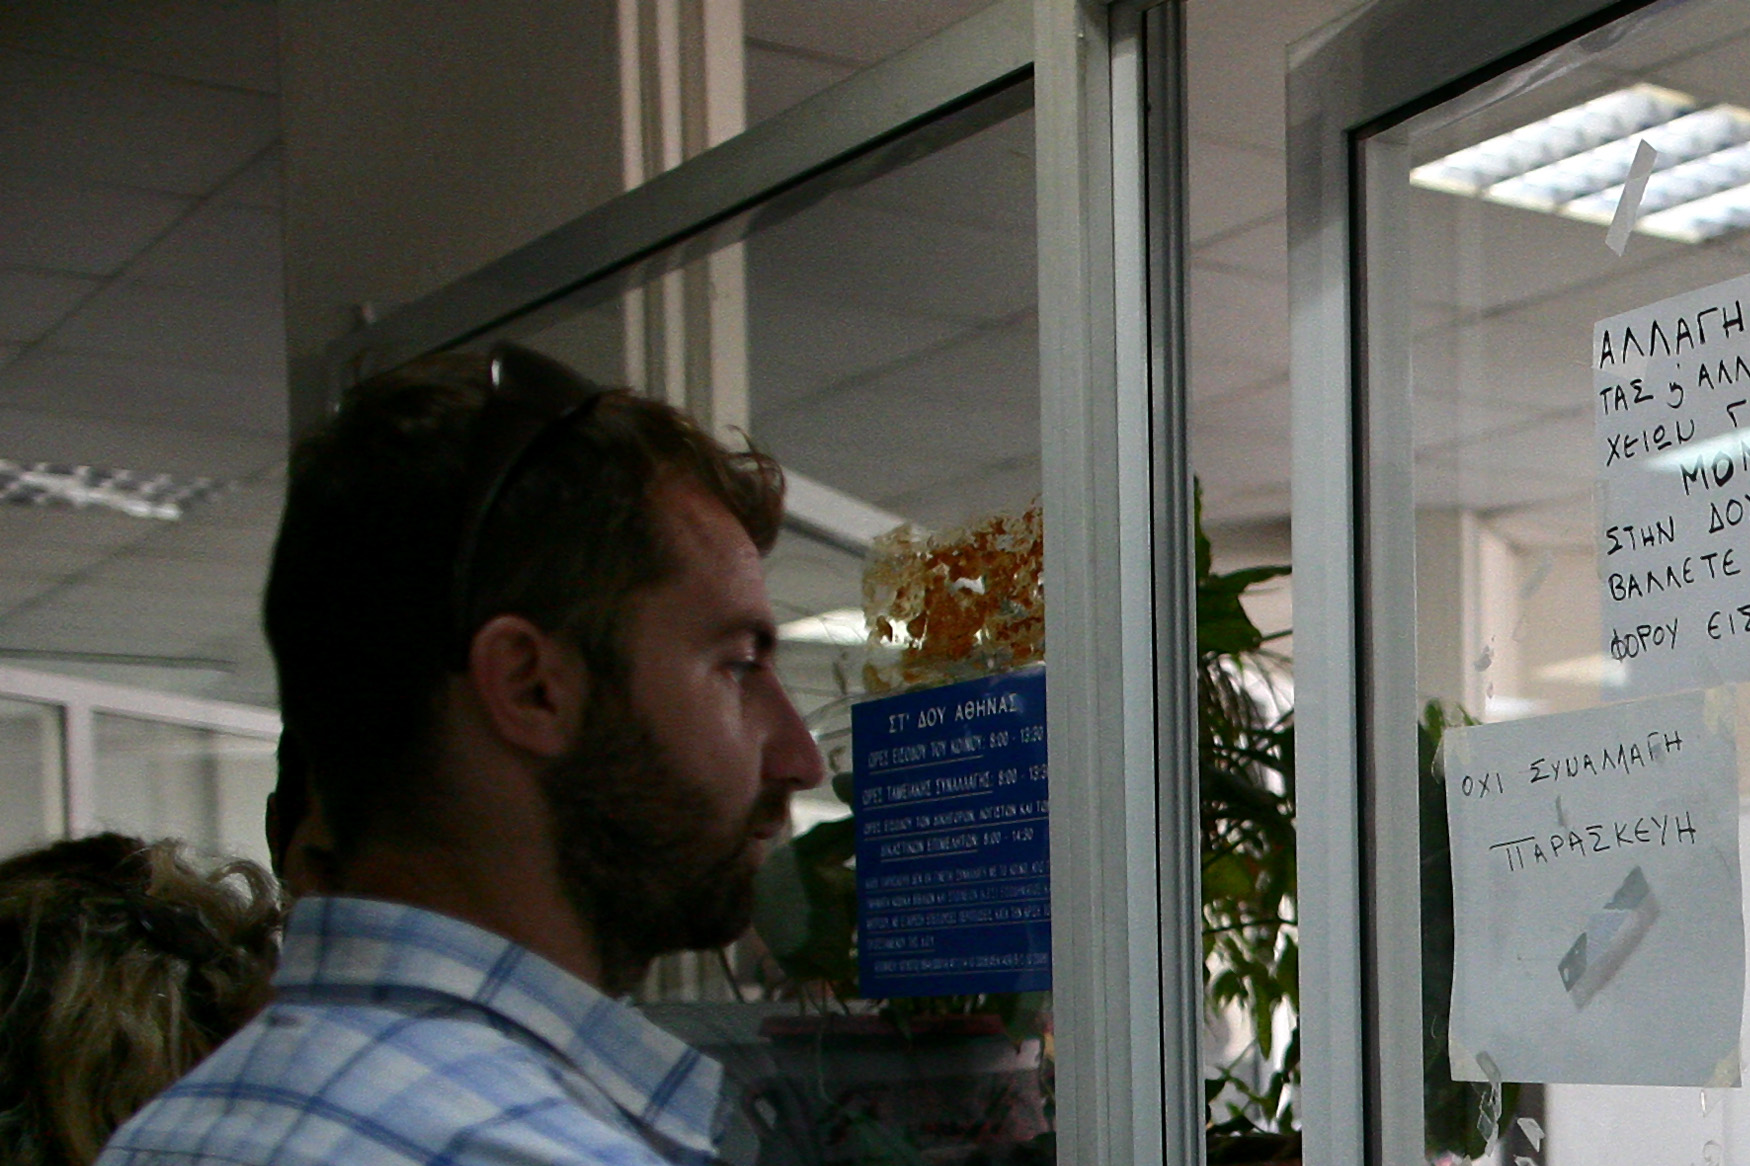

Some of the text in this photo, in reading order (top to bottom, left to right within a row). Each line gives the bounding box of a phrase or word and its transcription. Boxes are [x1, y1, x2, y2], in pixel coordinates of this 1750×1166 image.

[1599, 301, 1744, 368] ΑΛΛΑΓΗ
[1600, 378, 1654, 415] ΤΑΣ
[1605, 419, 1696, 467] ΧΕΙΩΝ
[1605, 515, 1675, 555] ΣΤΗΝ
[1608, 548, 1742, 601] ΒΑΛΛΕΤΕ
[1610, 618, 1679, 663] ΦΟΡΟΥ
[917, 706, 946, 729] ΔΟΥ
[954, 693, 1018, 722] ΑΘΗΝΑΣ
[1461, 773, 1504, 798] ΟΧΙ
[1489, 811, 1696, 872] ΠΑΡΑΣΚΕΥΗ
